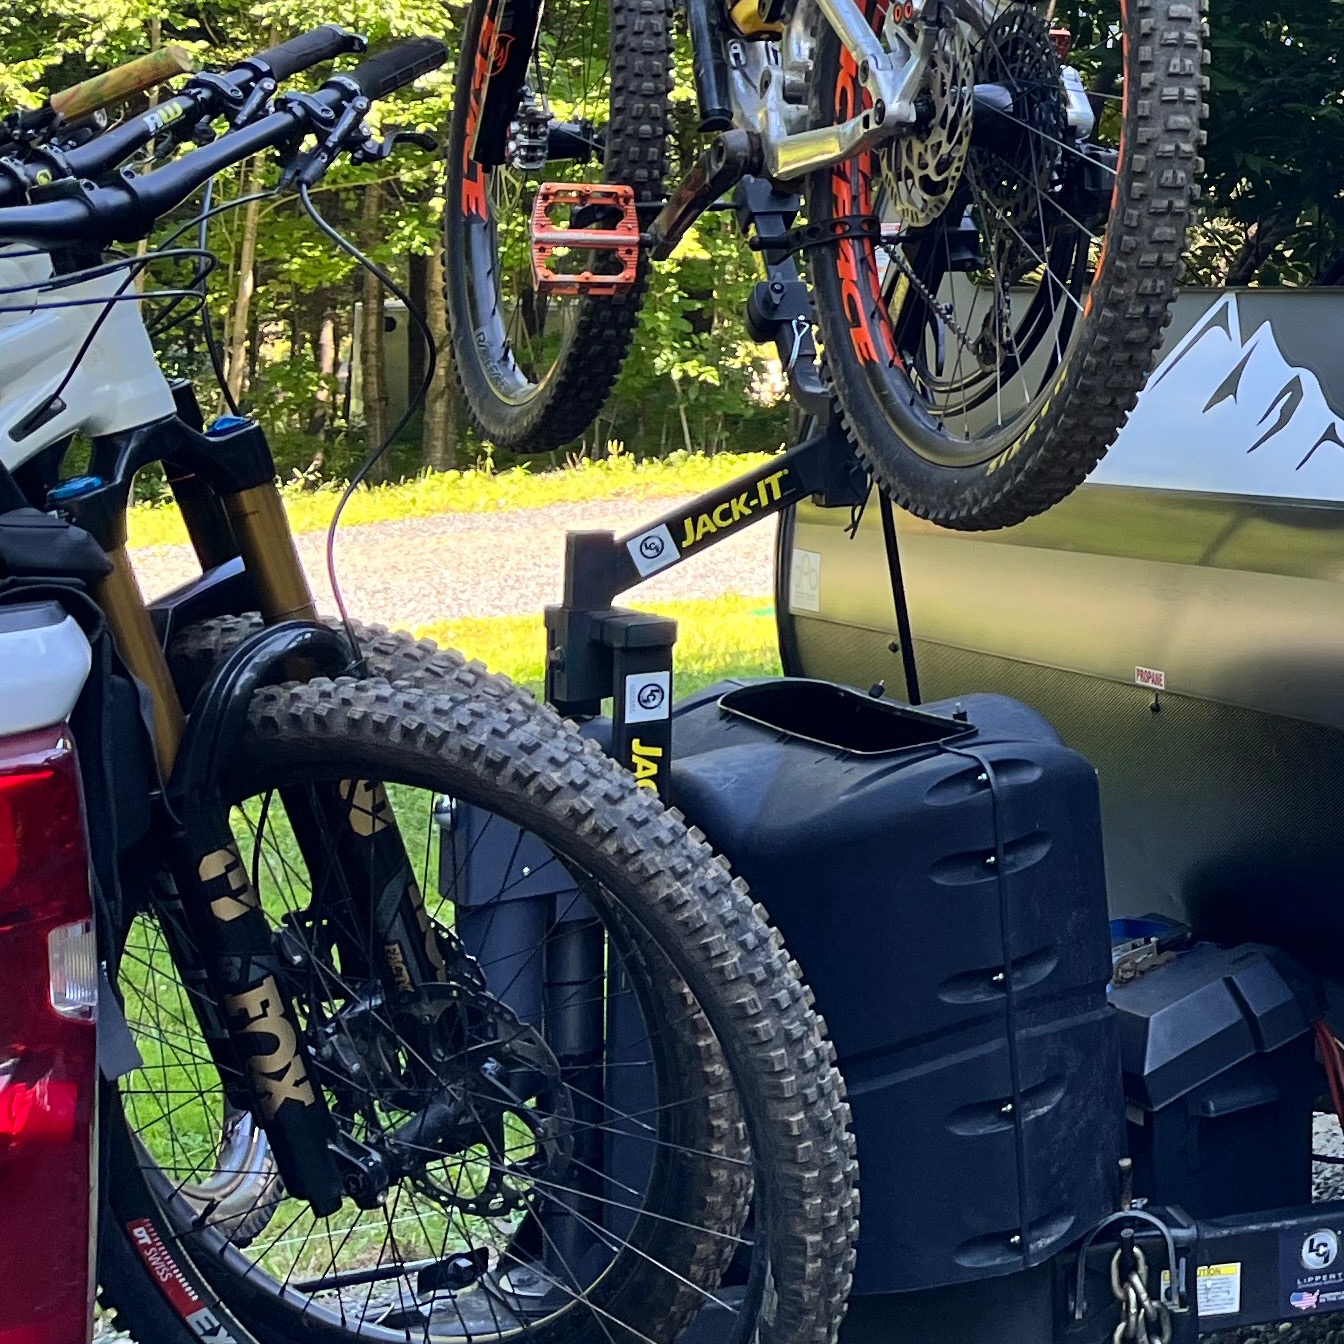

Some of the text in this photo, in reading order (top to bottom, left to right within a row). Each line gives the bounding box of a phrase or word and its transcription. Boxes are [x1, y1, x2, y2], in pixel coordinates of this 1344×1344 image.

[681, 470, 787, 548] JACK-IT
[227, 974, 316, 1121] FOX
[132, 1226, 173, 1283] DT SWISS
